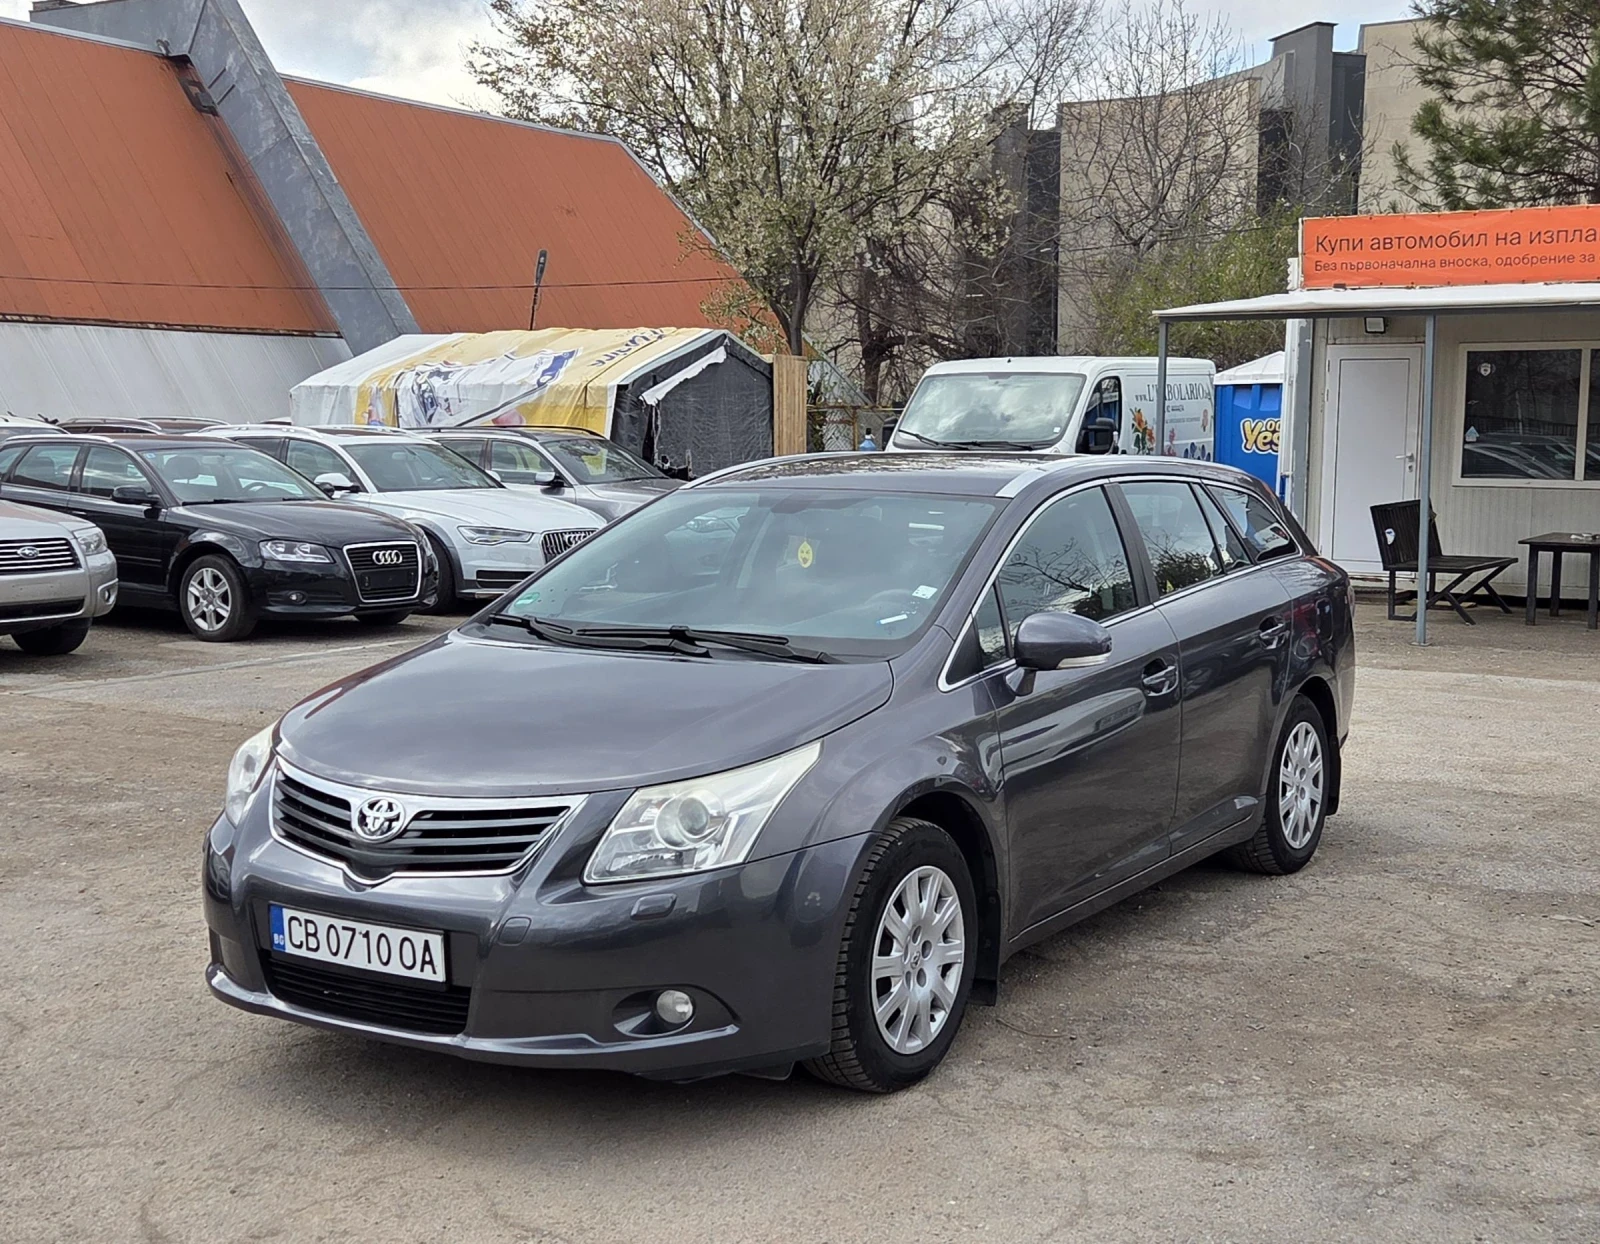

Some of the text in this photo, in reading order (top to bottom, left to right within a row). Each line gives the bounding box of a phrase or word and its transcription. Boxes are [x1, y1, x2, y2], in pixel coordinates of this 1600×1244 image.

[1316, 227, 1600, 256] Купи автомобил на изпла
[1314, 252, 1596, 272] Без първоначална вноска, одобрение за
[273, 933, 285, 945] BG
[287, 915, 438, 975] CB 0710 OA
